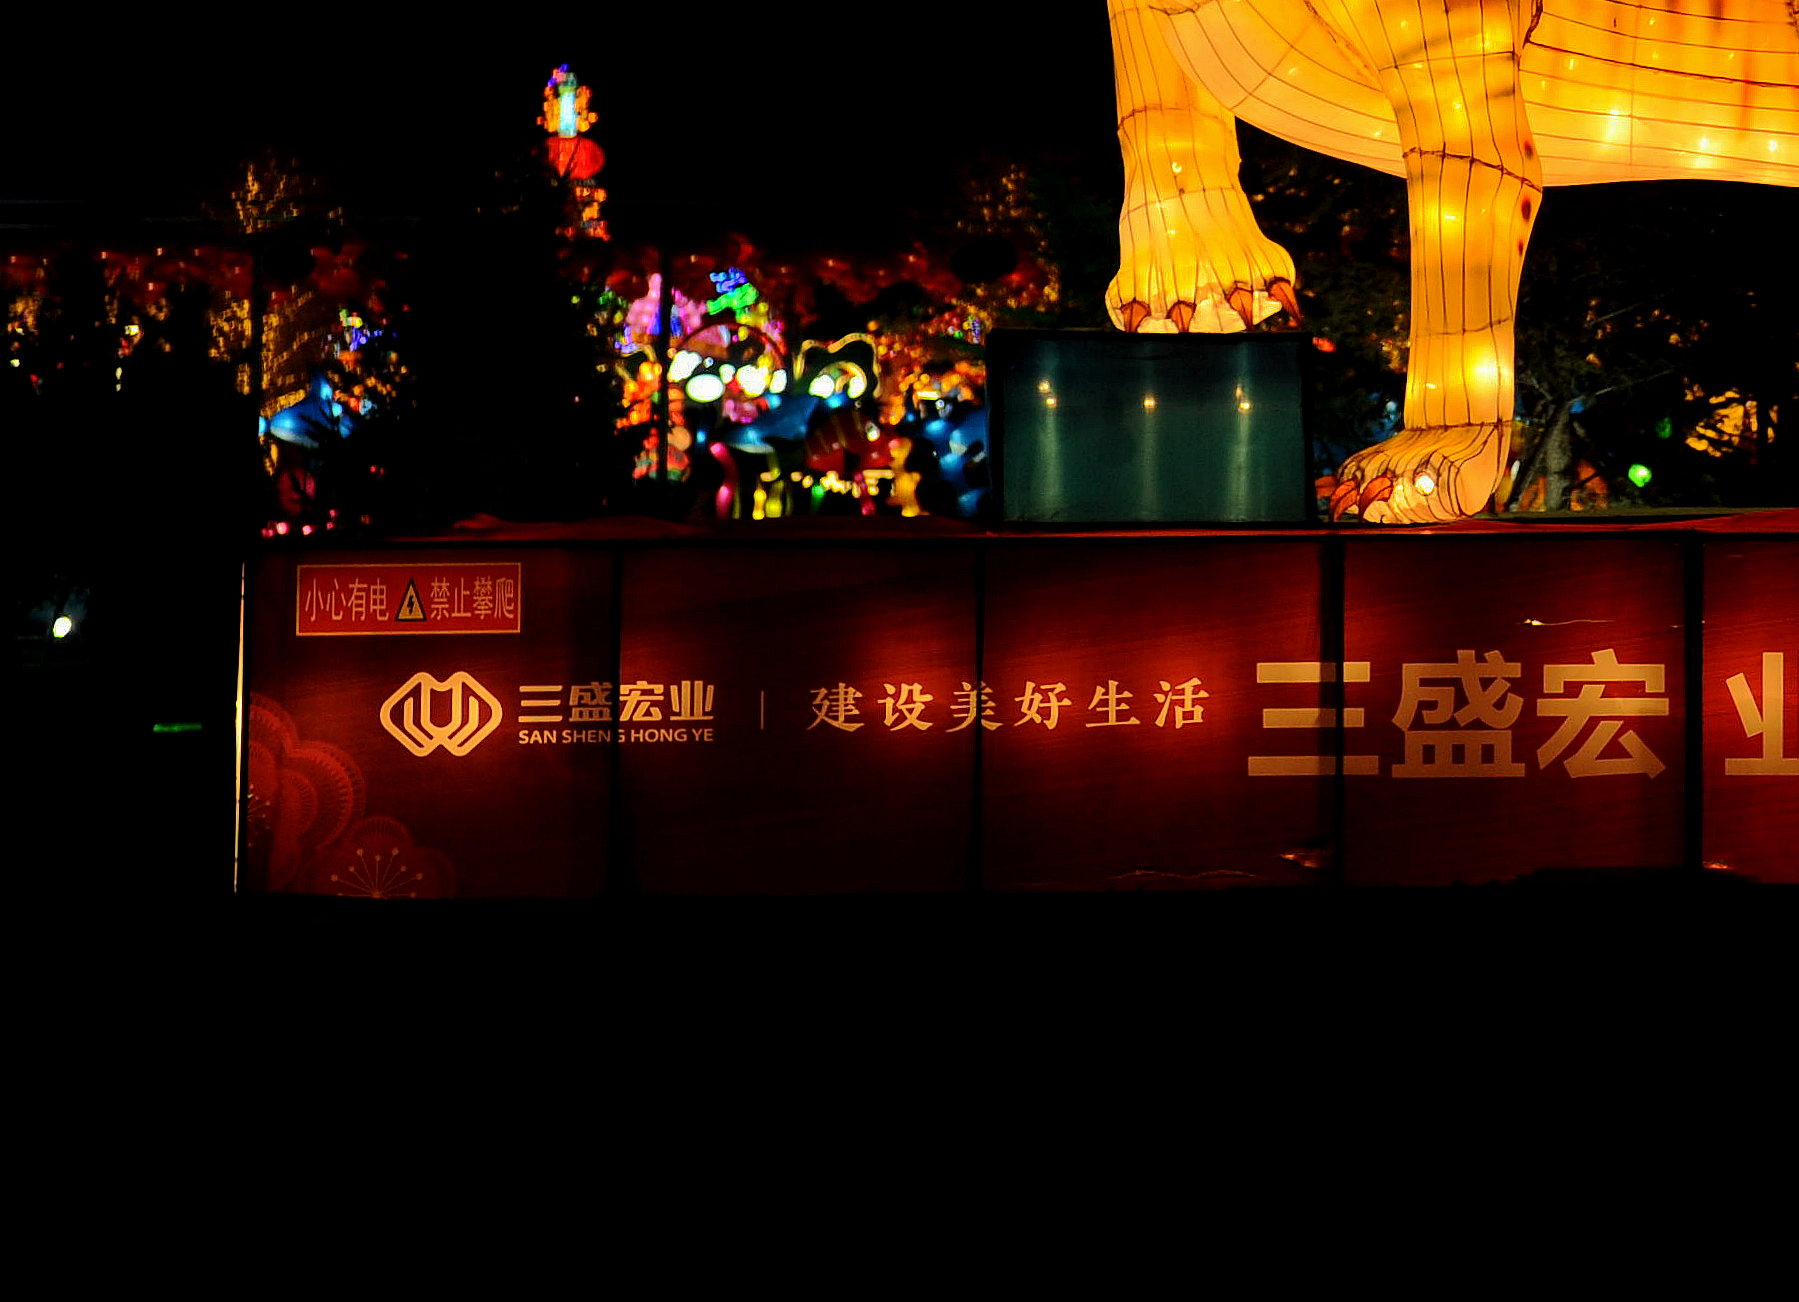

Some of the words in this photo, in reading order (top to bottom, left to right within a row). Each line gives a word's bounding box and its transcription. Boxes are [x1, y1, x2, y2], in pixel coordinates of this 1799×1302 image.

[304, 575, 389, 623] 小心有电
[430, 574, 515, 621] 禁止攀爬
[517, 680, 715, 723] 三盛宏业
[805, 675, 1211, 734] 建设美好生活
[518, 729, 557, 745] SAN
[630, 728, 688, 743] HONG
[691, 727, 714, 742] YE
